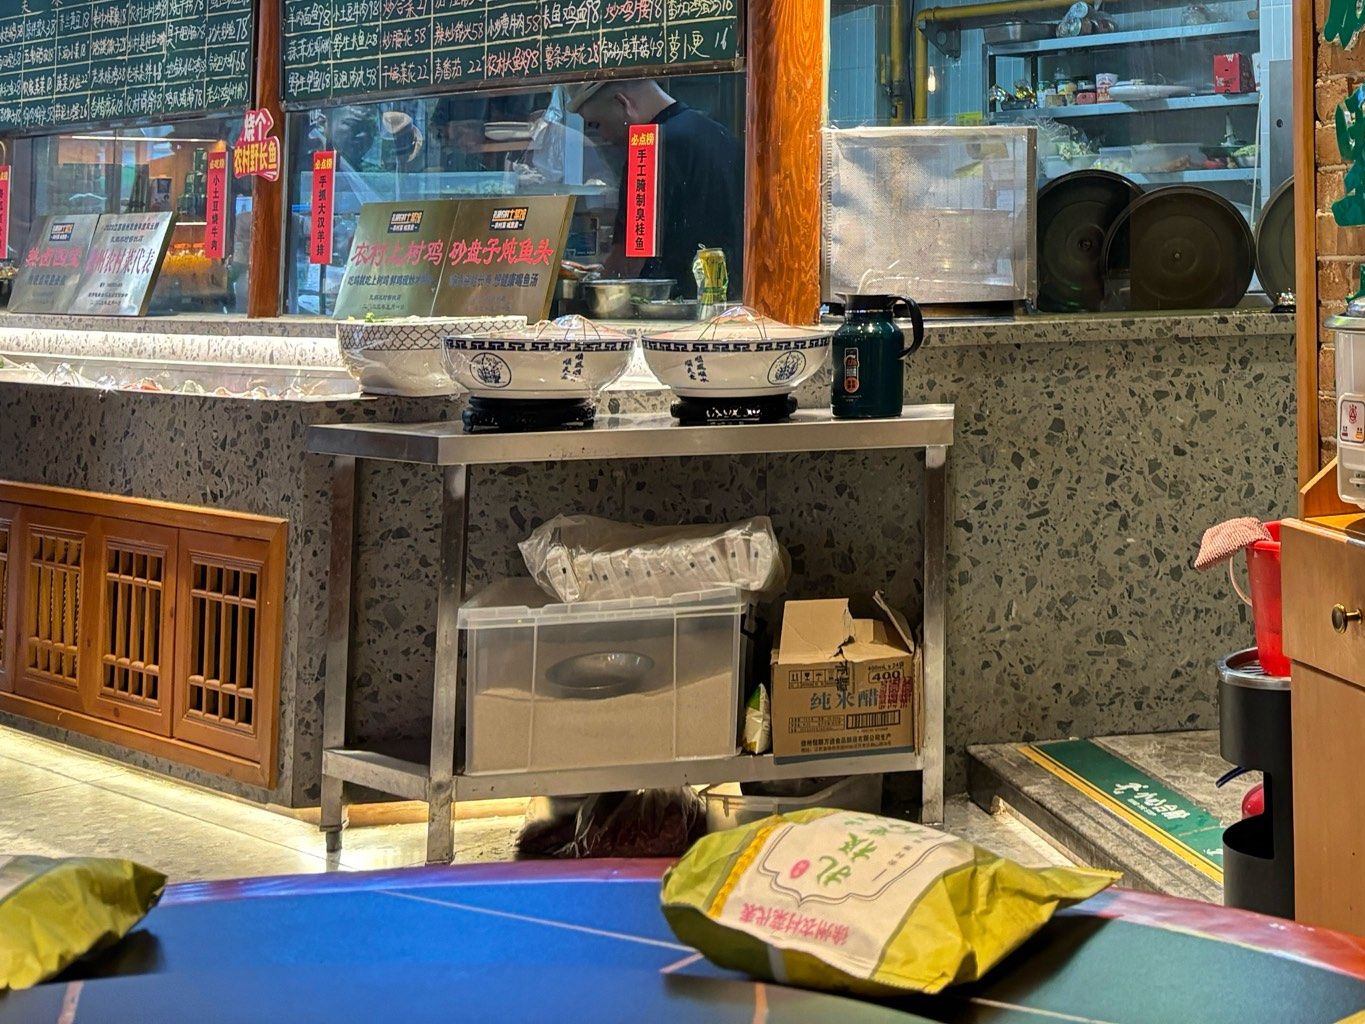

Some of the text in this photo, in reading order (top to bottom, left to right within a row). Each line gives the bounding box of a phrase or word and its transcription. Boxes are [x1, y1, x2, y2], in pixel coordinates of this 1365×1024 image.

[631, 132, 655, 146] 必点榜
[233, 141, 278, 174] 农村野长鱼
[635, 149, 648, 251] 手工腌制臭桂鱼
[810, 687, 879, 711] 纯米醋
[739, 902, 849, 946] 徐州农村菜代表
